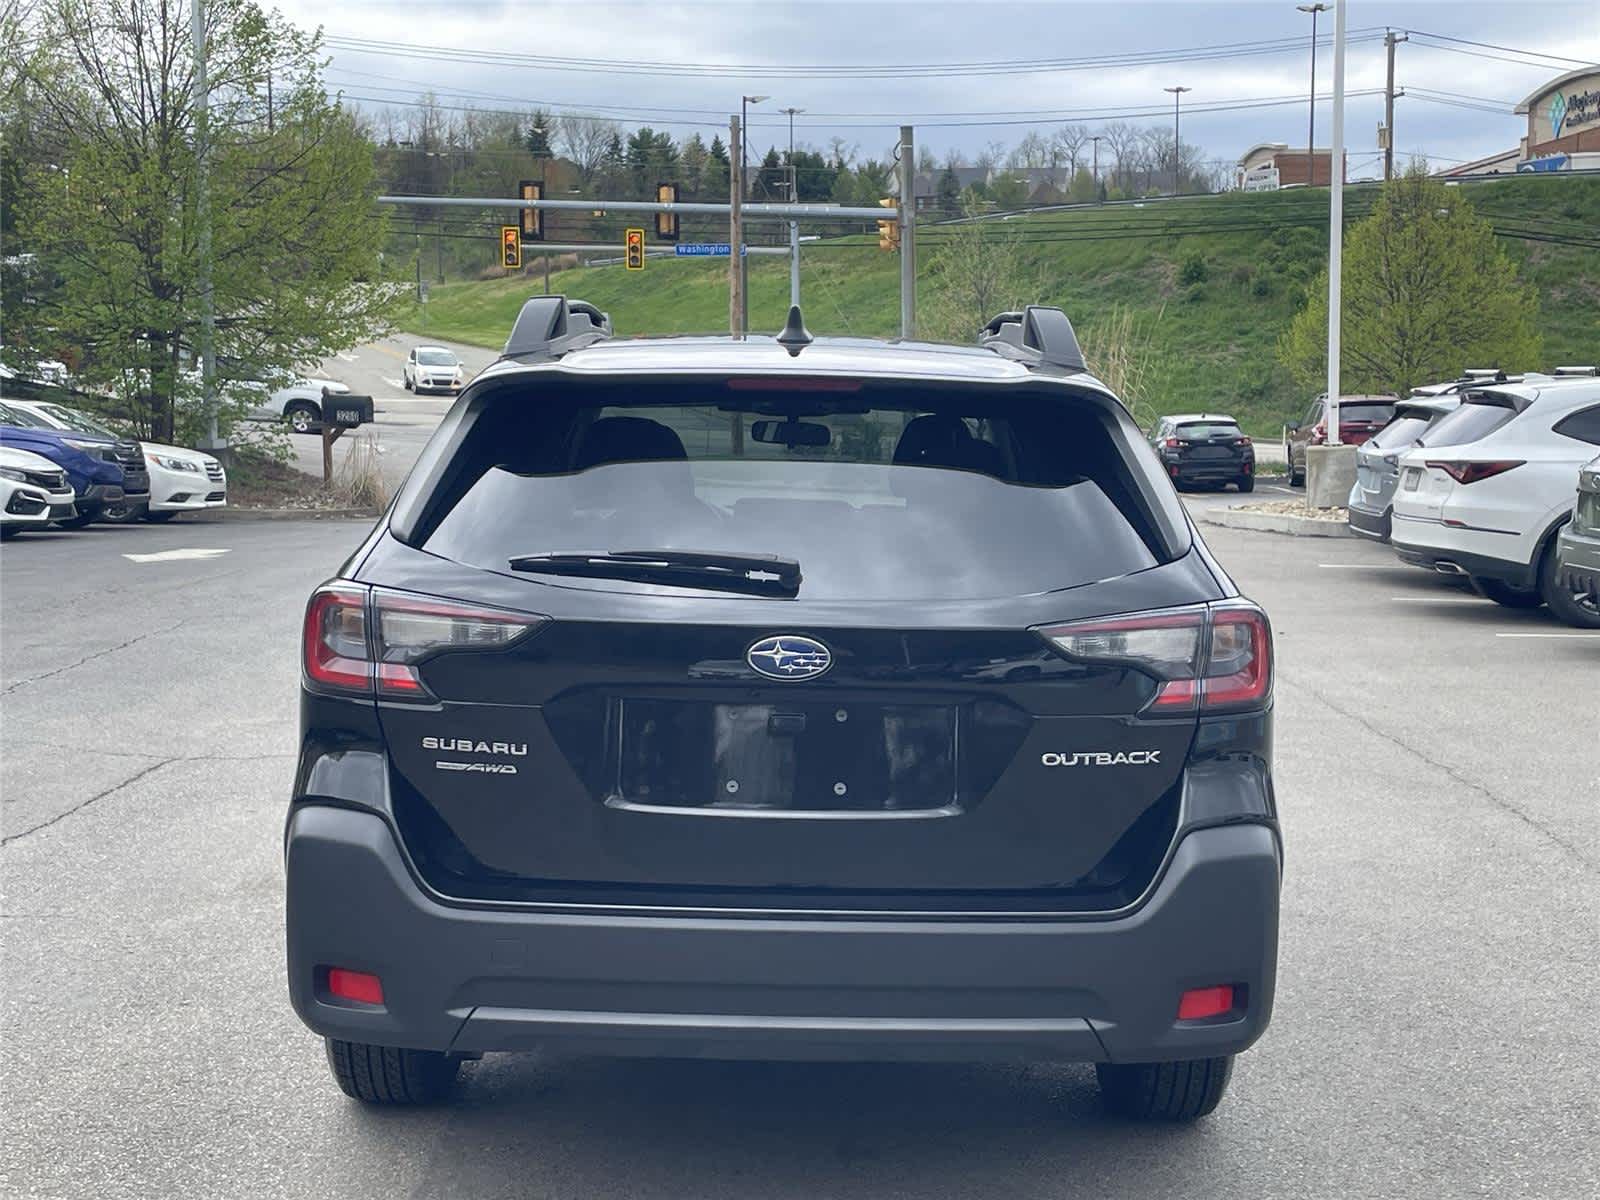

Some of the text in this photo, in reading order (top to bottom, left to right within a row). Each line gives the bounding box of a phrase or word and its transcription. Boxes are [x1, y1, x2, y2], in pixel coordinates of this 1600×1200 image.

[679, 245, 730, 255] Washington
[422, 737, 528, 756] SUBARU
[1041, 750, 1161, 766] OUTBACK
[466, 763, 518, 774] AWD
